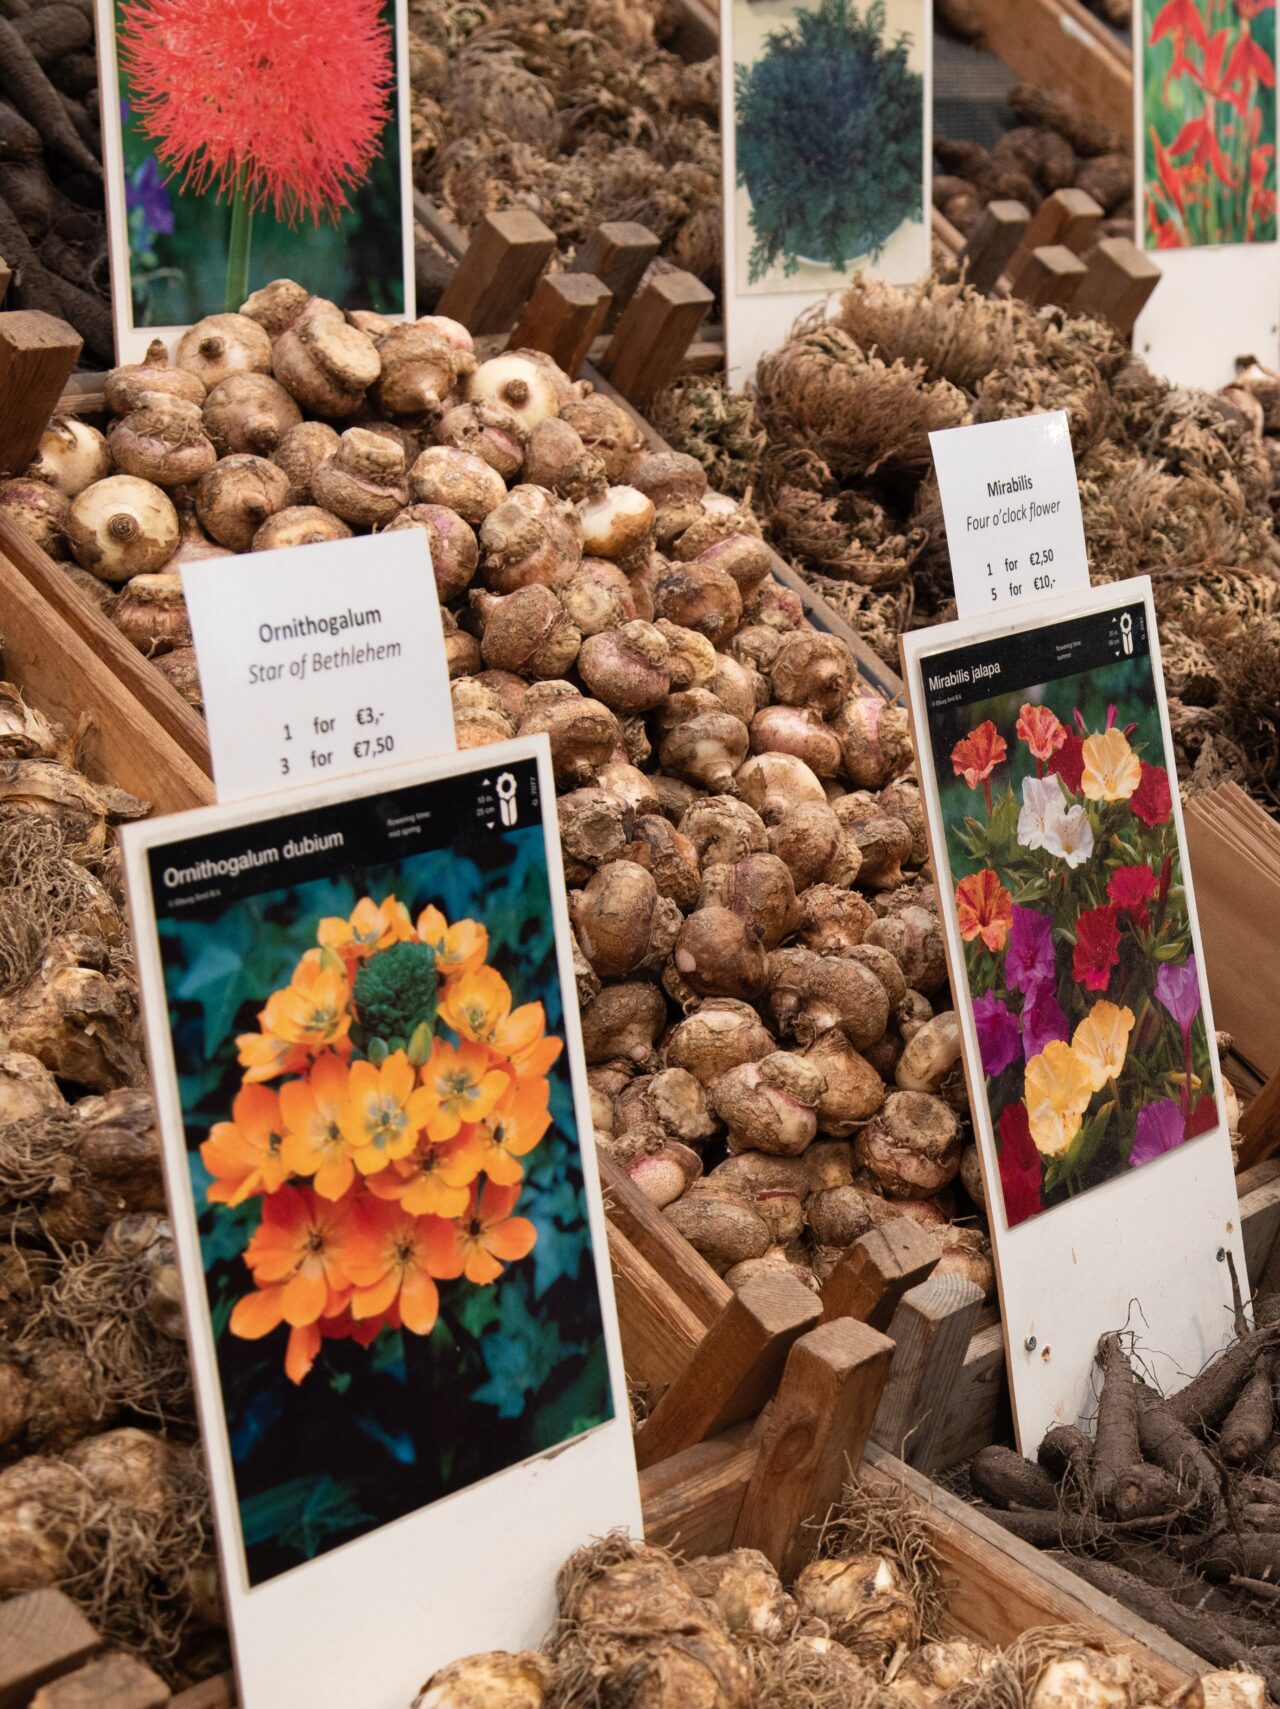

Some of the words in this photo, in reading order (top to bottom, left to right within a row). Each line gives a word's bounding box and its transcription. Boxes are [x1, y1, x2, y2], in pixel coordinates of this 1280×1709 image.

[987, 475, 1033, 498] Mirabilis
[966, 515, 989, 532] Four
[1028, 500, 1061, 522] flower
[986, 563, 993, 576] 1
[1004, 557, 1019, 573] for
[1029, 549, 1054, 566] €2,50
[991, 588, 998, 601] 5
[1009, 582, 1023, 597] for
[258, 606, 382, 643] Ornithogalum
[248, 660, 284, 685] Star
[289, 654, 309, 680] of
[312, 640, 402, 673] Bethlehem
[928, 668, 970, 692] Mirabilis
[971, 662, 1001, 684] jalapa
[284, 725, 293, 741] 1
[314, 715, 336, 735] for
[356, 707, 385, 726] €3,-
[280, 758, 290, 775] 3
[310, 749, 334, 768] for
[353, 735, 394, 758] €7,50
[163, 848, 280, 888] Ornithogalum
[283, 831, 344, 859] dubium
